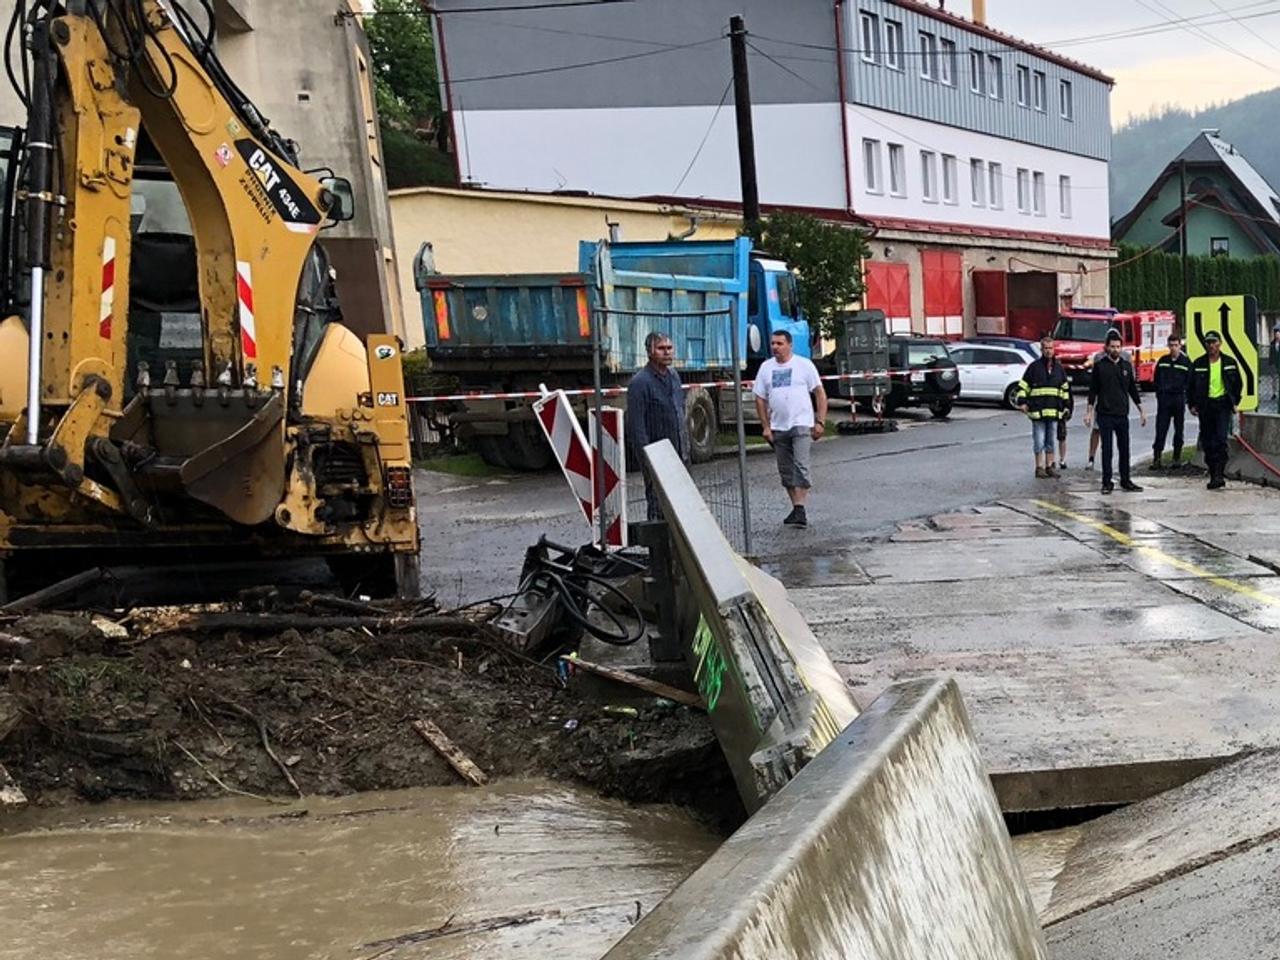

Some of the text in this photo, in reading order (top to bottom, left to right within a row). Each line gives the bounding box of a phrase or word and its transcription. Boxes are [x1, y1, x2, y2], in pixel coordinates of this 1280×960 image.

[249, 149, 301, 219] CAT 434E
[378, 392, 397, 406] CAT
